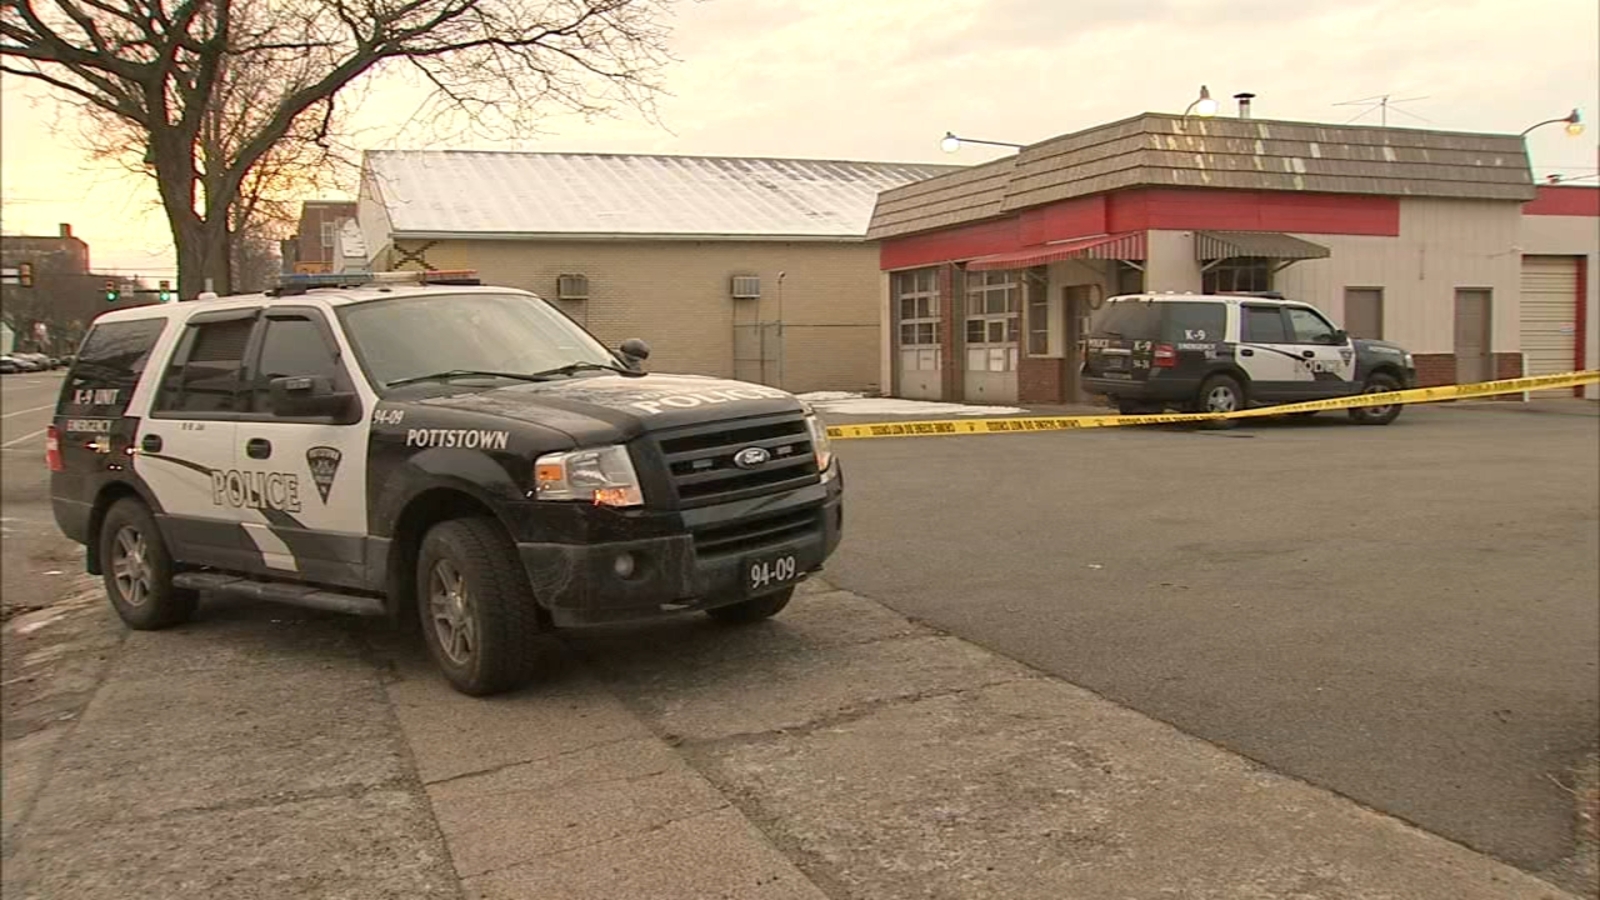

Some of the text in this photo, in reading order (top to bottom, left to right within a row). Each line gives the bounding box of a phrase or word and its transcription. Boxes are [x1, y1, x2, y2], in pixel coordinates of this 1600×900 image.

[1184, 329, 1206, 341] K-9
[630, 384, 787, 414] POLICE
[372, 410, 405, 425] 94-09
[406, 429, 510, 449] POTTSTOWN
[211, 469, 302, 513] POLICE
[751, 556, 795, 588] 94-09
